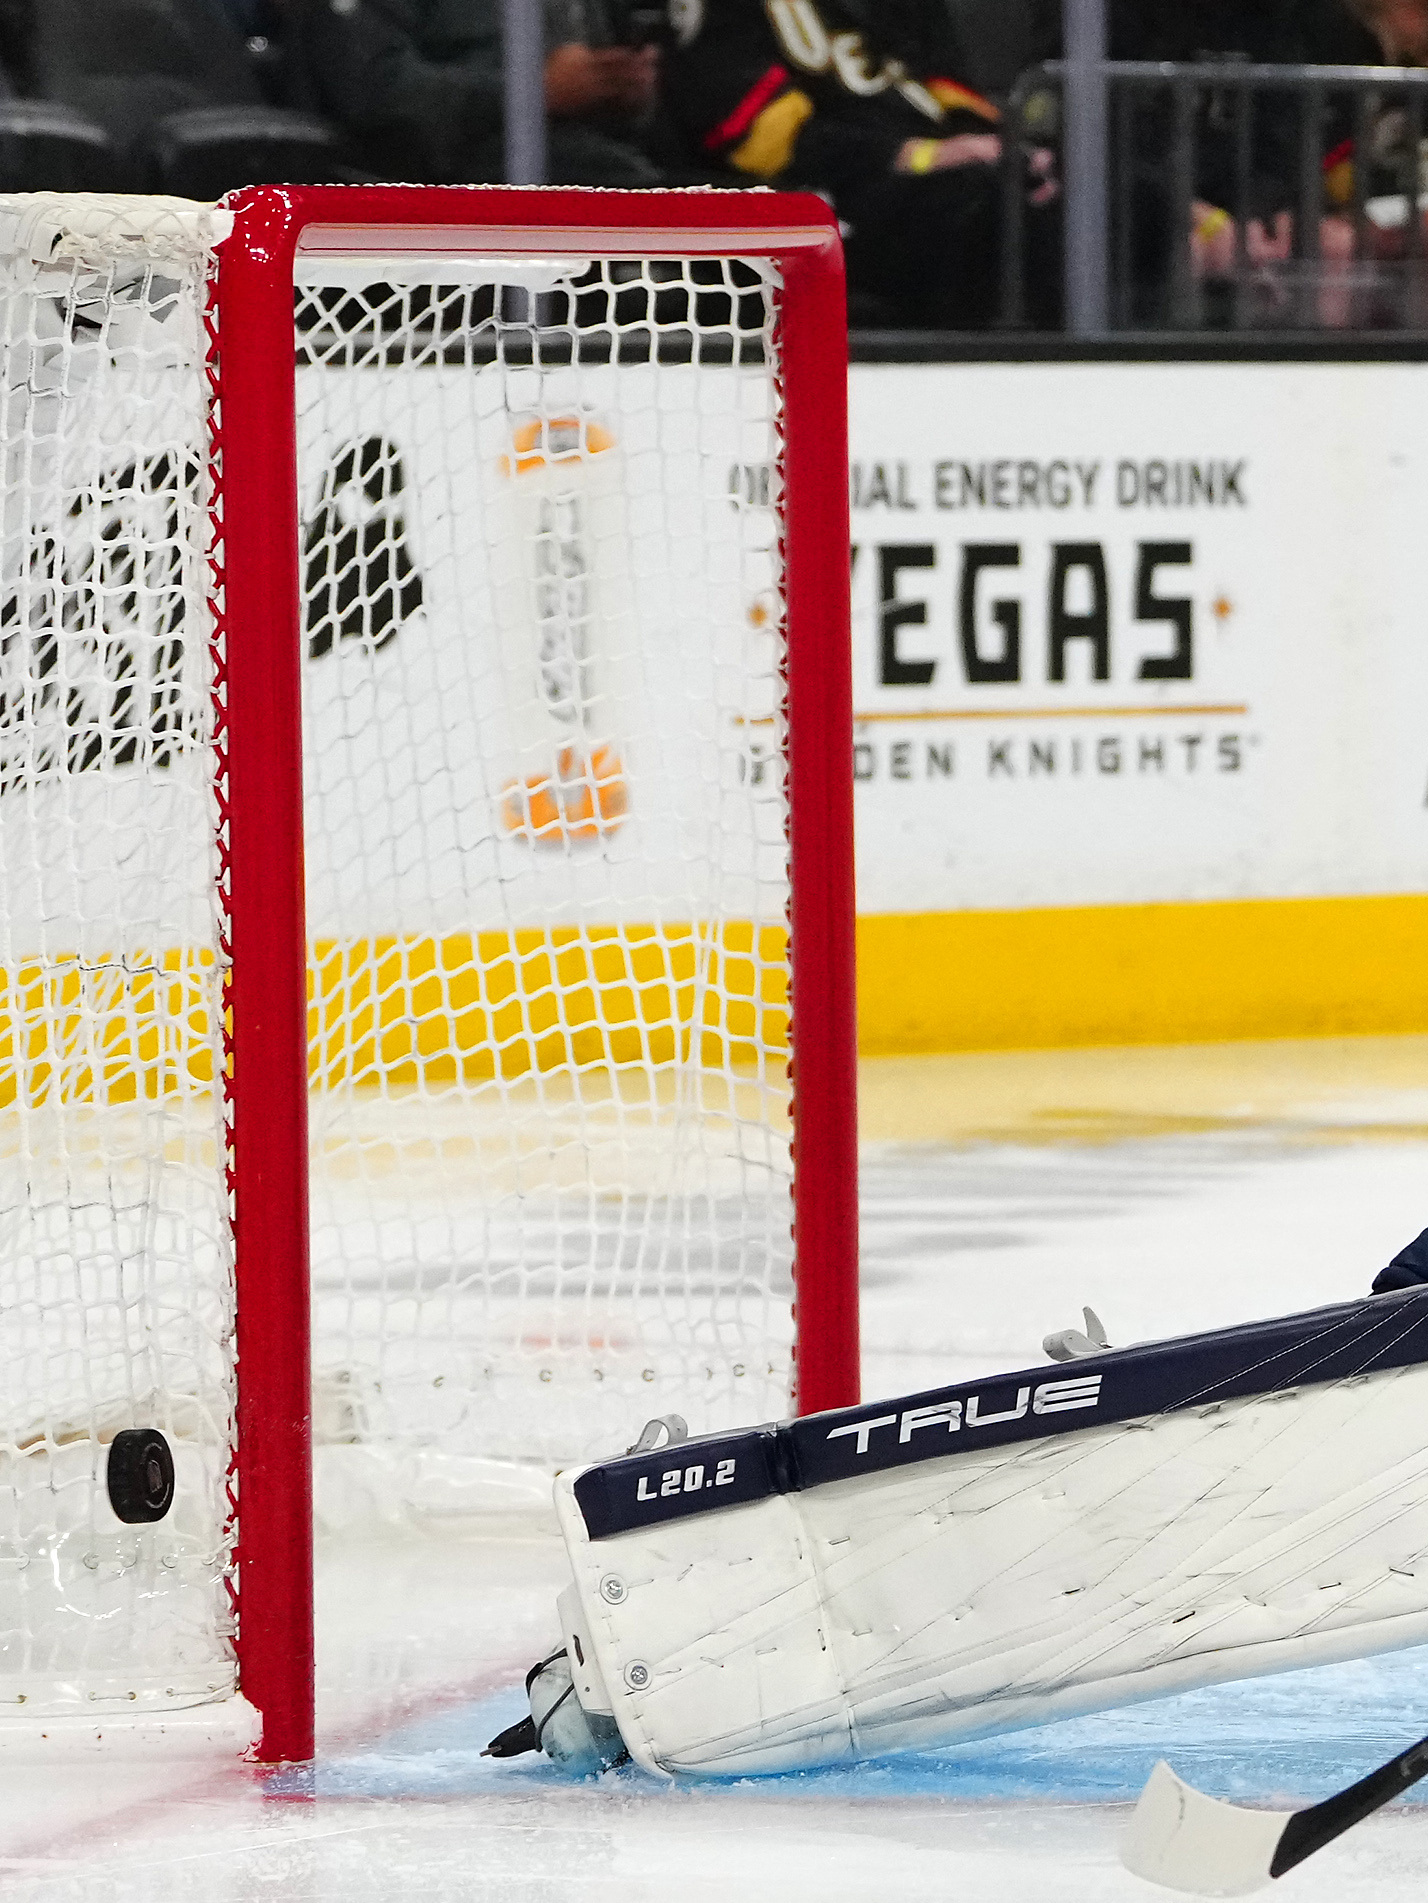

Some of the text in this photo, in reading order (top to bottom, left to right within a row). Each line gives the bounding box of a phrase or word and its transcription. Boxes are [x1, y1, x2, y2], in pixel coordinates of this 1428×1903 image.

[933, 459, 1100, 509] ENERGY
[1115, 458, 1249, 508] DRINK
[850, 540, 1194, 686] EGAS
[737, 731, 1244, 784] GDEN KNIGHTS
[826, 1373, 1103, 1455] TRUE
[635, 1458, 736, 1503] L20.2
